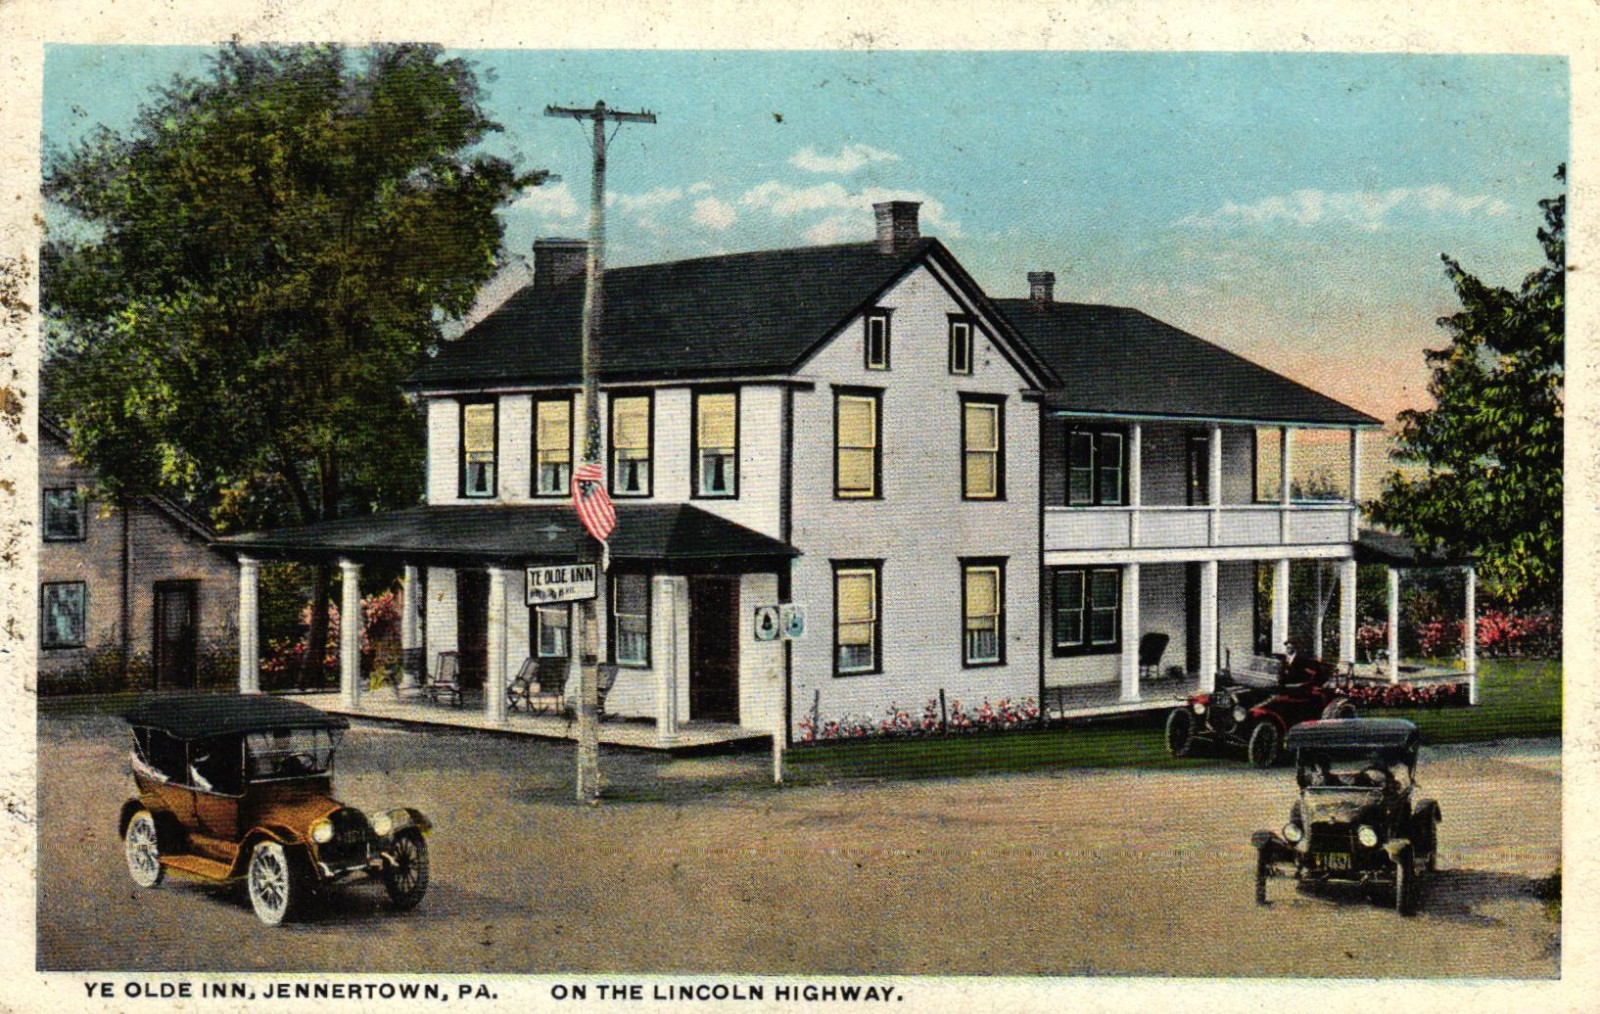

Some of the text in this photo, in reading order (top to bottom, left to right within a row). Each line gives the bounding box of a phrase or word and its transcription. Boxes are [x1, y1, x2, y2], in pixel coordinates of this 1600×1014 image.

[530, 566, 593, 586] YE OLDE INN
